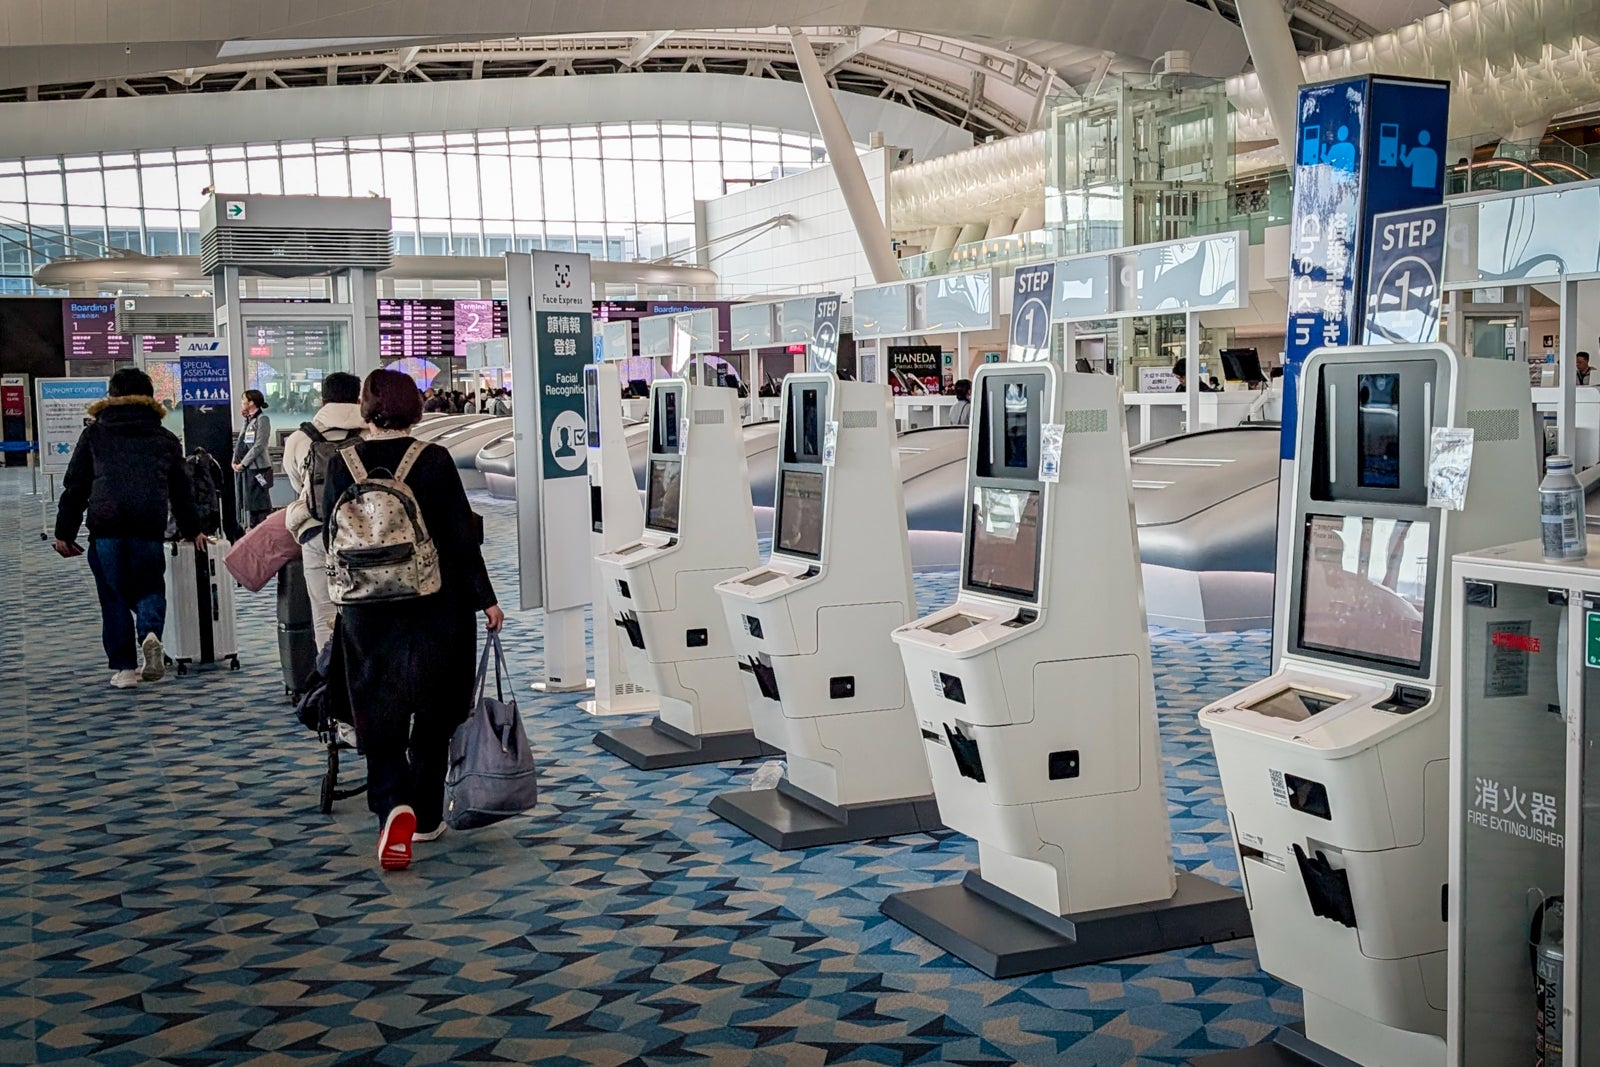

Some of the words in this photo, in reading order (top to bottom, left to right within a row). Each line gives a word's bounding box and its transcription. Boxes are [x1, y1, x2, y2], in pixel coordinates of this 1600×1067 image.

[1382, 219, 1437, 251] STEP
[1298, 214, 1320, 312] Check
[1018, 271, 1049, 294] STEP
[1322, 212, 1348, 347] 搭乗手続き
[542, 294, 557, 304] Face
[558, 294, 583, 306] Express
[1391, 270, 1413, 328] 1
[71, 303, 108, 314] Boarding
[654, 305, 682, 313] Boarding
[817, 301, 837, 318] STEP
[73, 322, 78, 331] 1
[107, 322, 115, 331] 2
[467, 313, 480, 332] 2
[547, 316, 581, 334] 顔情報
[1024, 308, 1036, 349] 1
[1295, 318, 1315, 346] In
[187, 343, 209, 351] ANA
[554, 339, 576, 356] 登録
[183, 361, 212, 369] SPECIAL
[894, 353, 936, 363] HANEDA
[945, 355, 952, 365] D
[992, 355, 999, 363] D
[556, 373, 578, 383] Facial
[545, 385, 585, 397] Recognitio
[1475, 777, 1557, 828] 消火器
[1467, 809, 1489, 827] FIRE
[1490, 816, 1565, 848] EXTINGUISHER
[1545, 983, 1557, 1030] YA-10X
